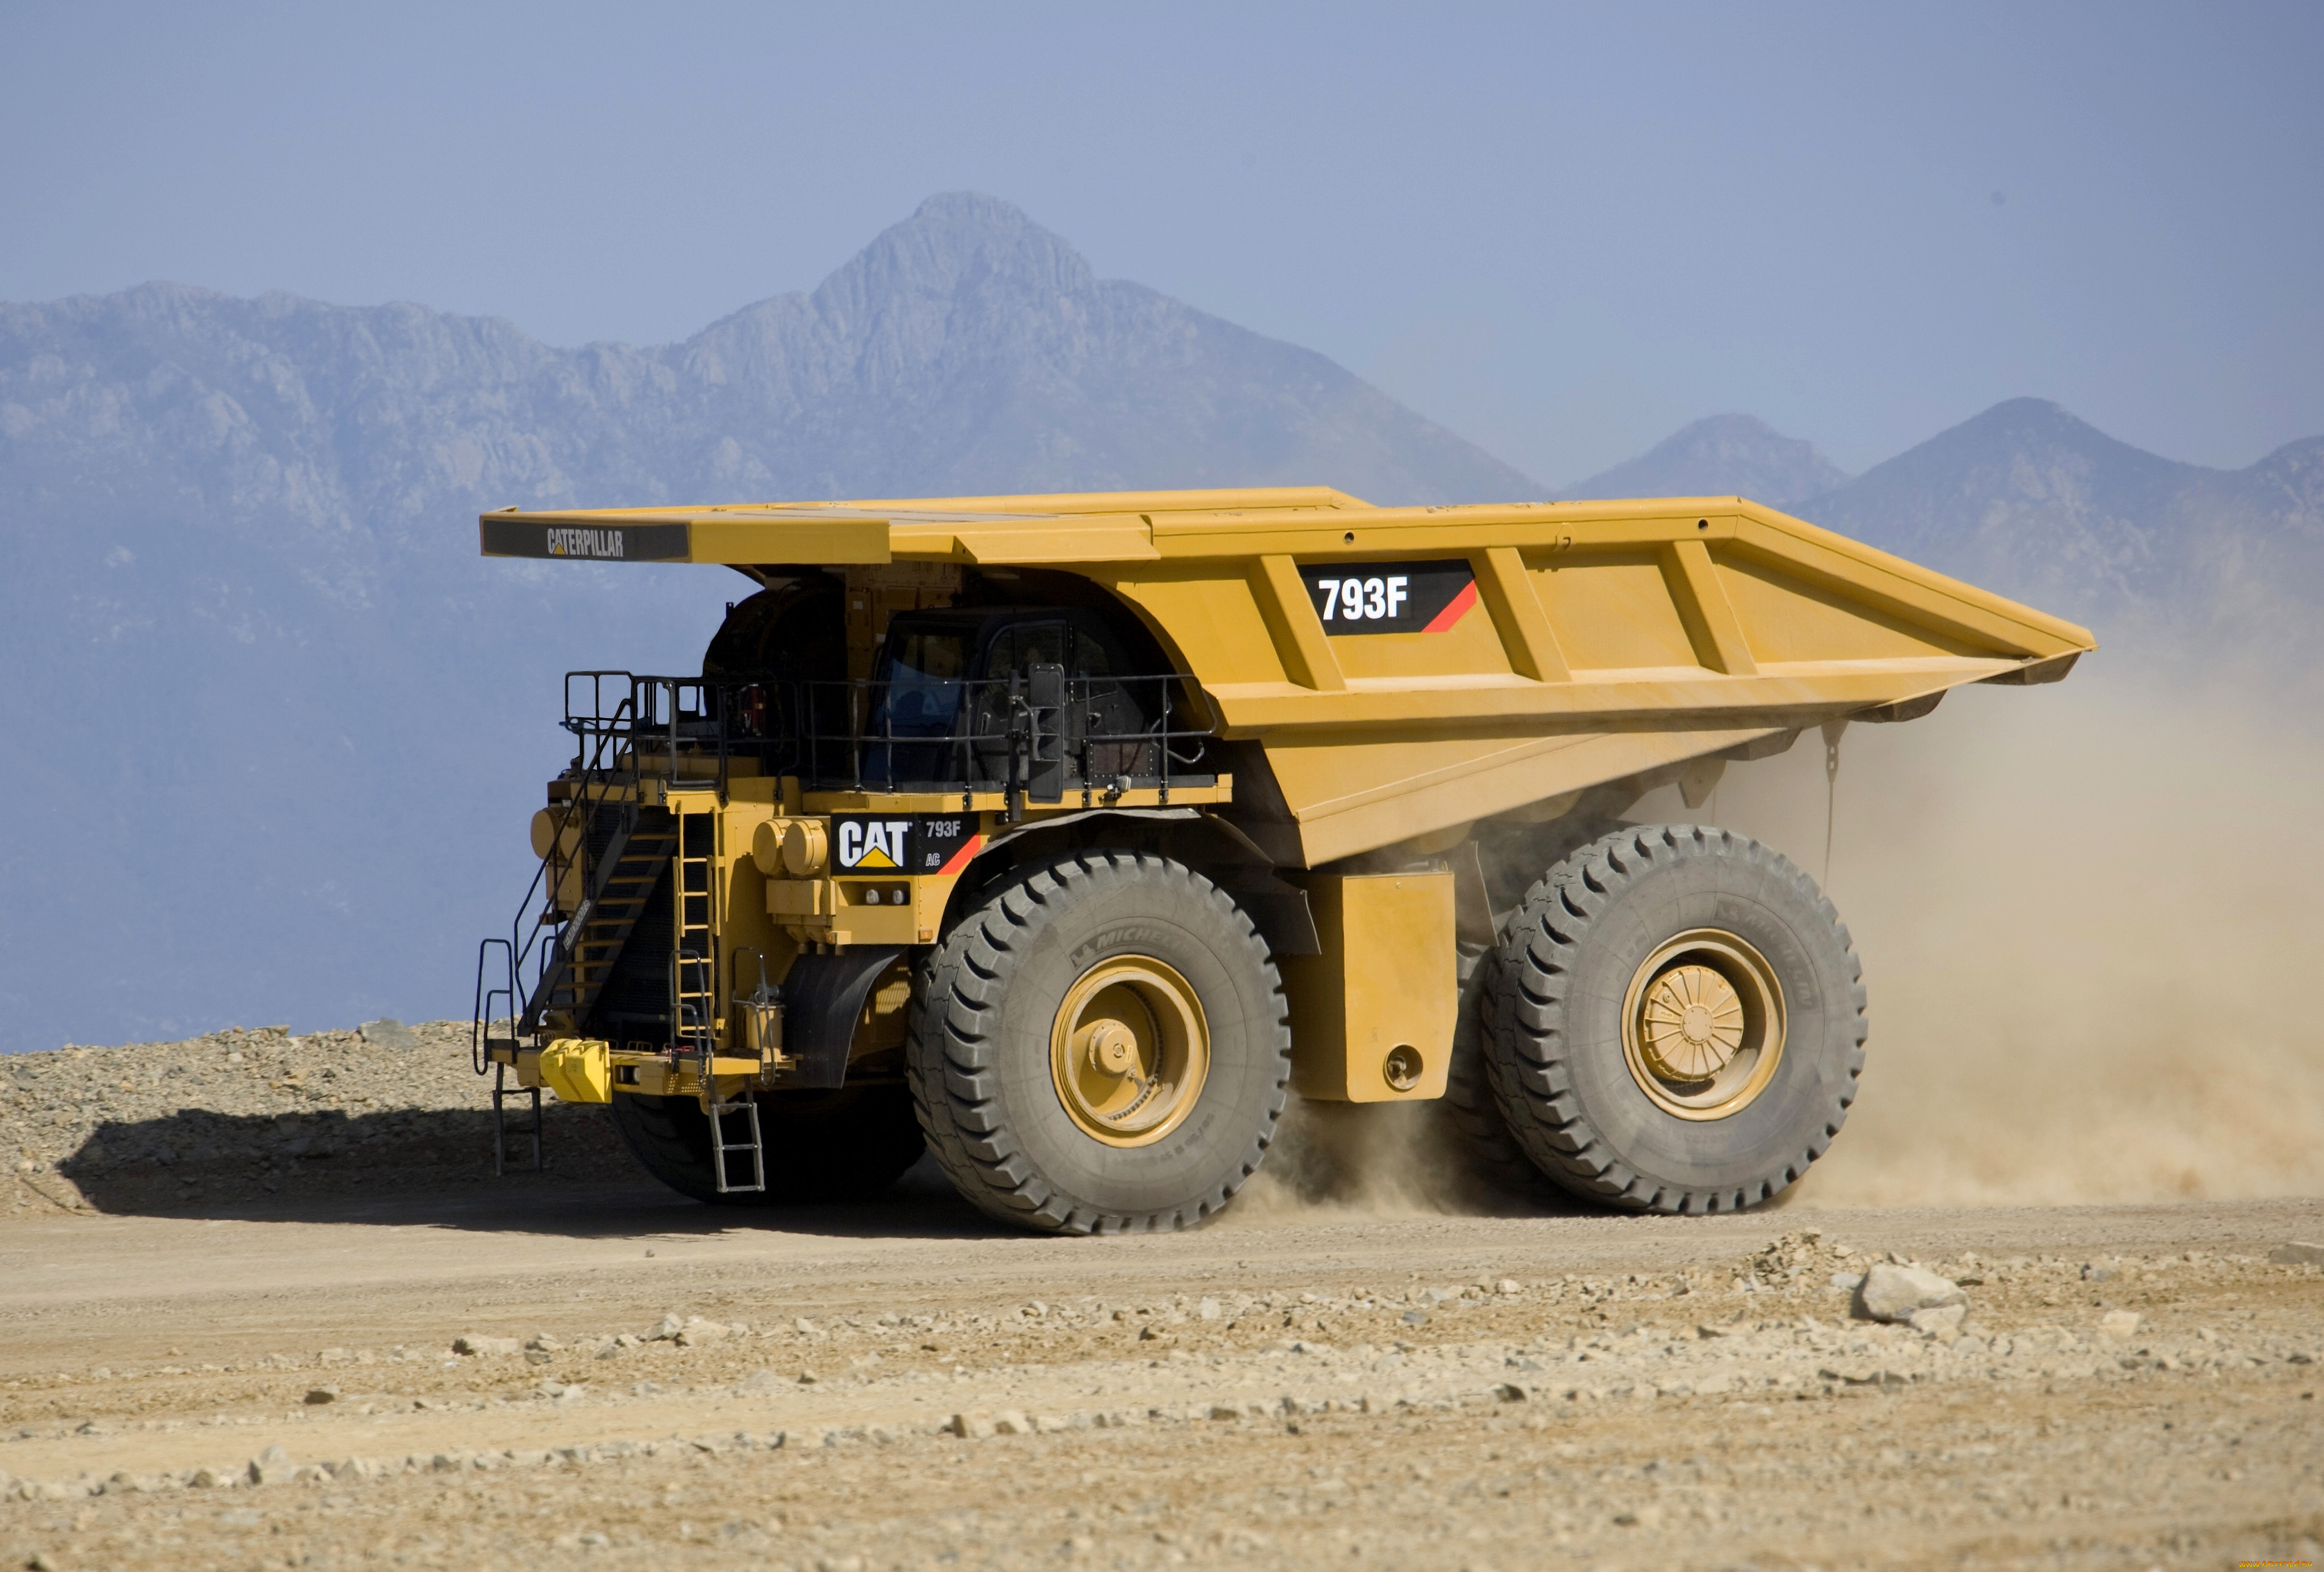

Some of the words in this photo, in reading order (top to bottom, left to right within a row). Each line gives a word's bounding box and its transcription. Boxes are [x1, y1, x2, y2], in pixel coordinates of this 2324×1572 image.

[548, 528, 624, 557] CATERPILLAR
[1319, 576, 1408, 620] 793F
[926, 820, 961, 838] 793F
[925, 853, 941, 867] AC
